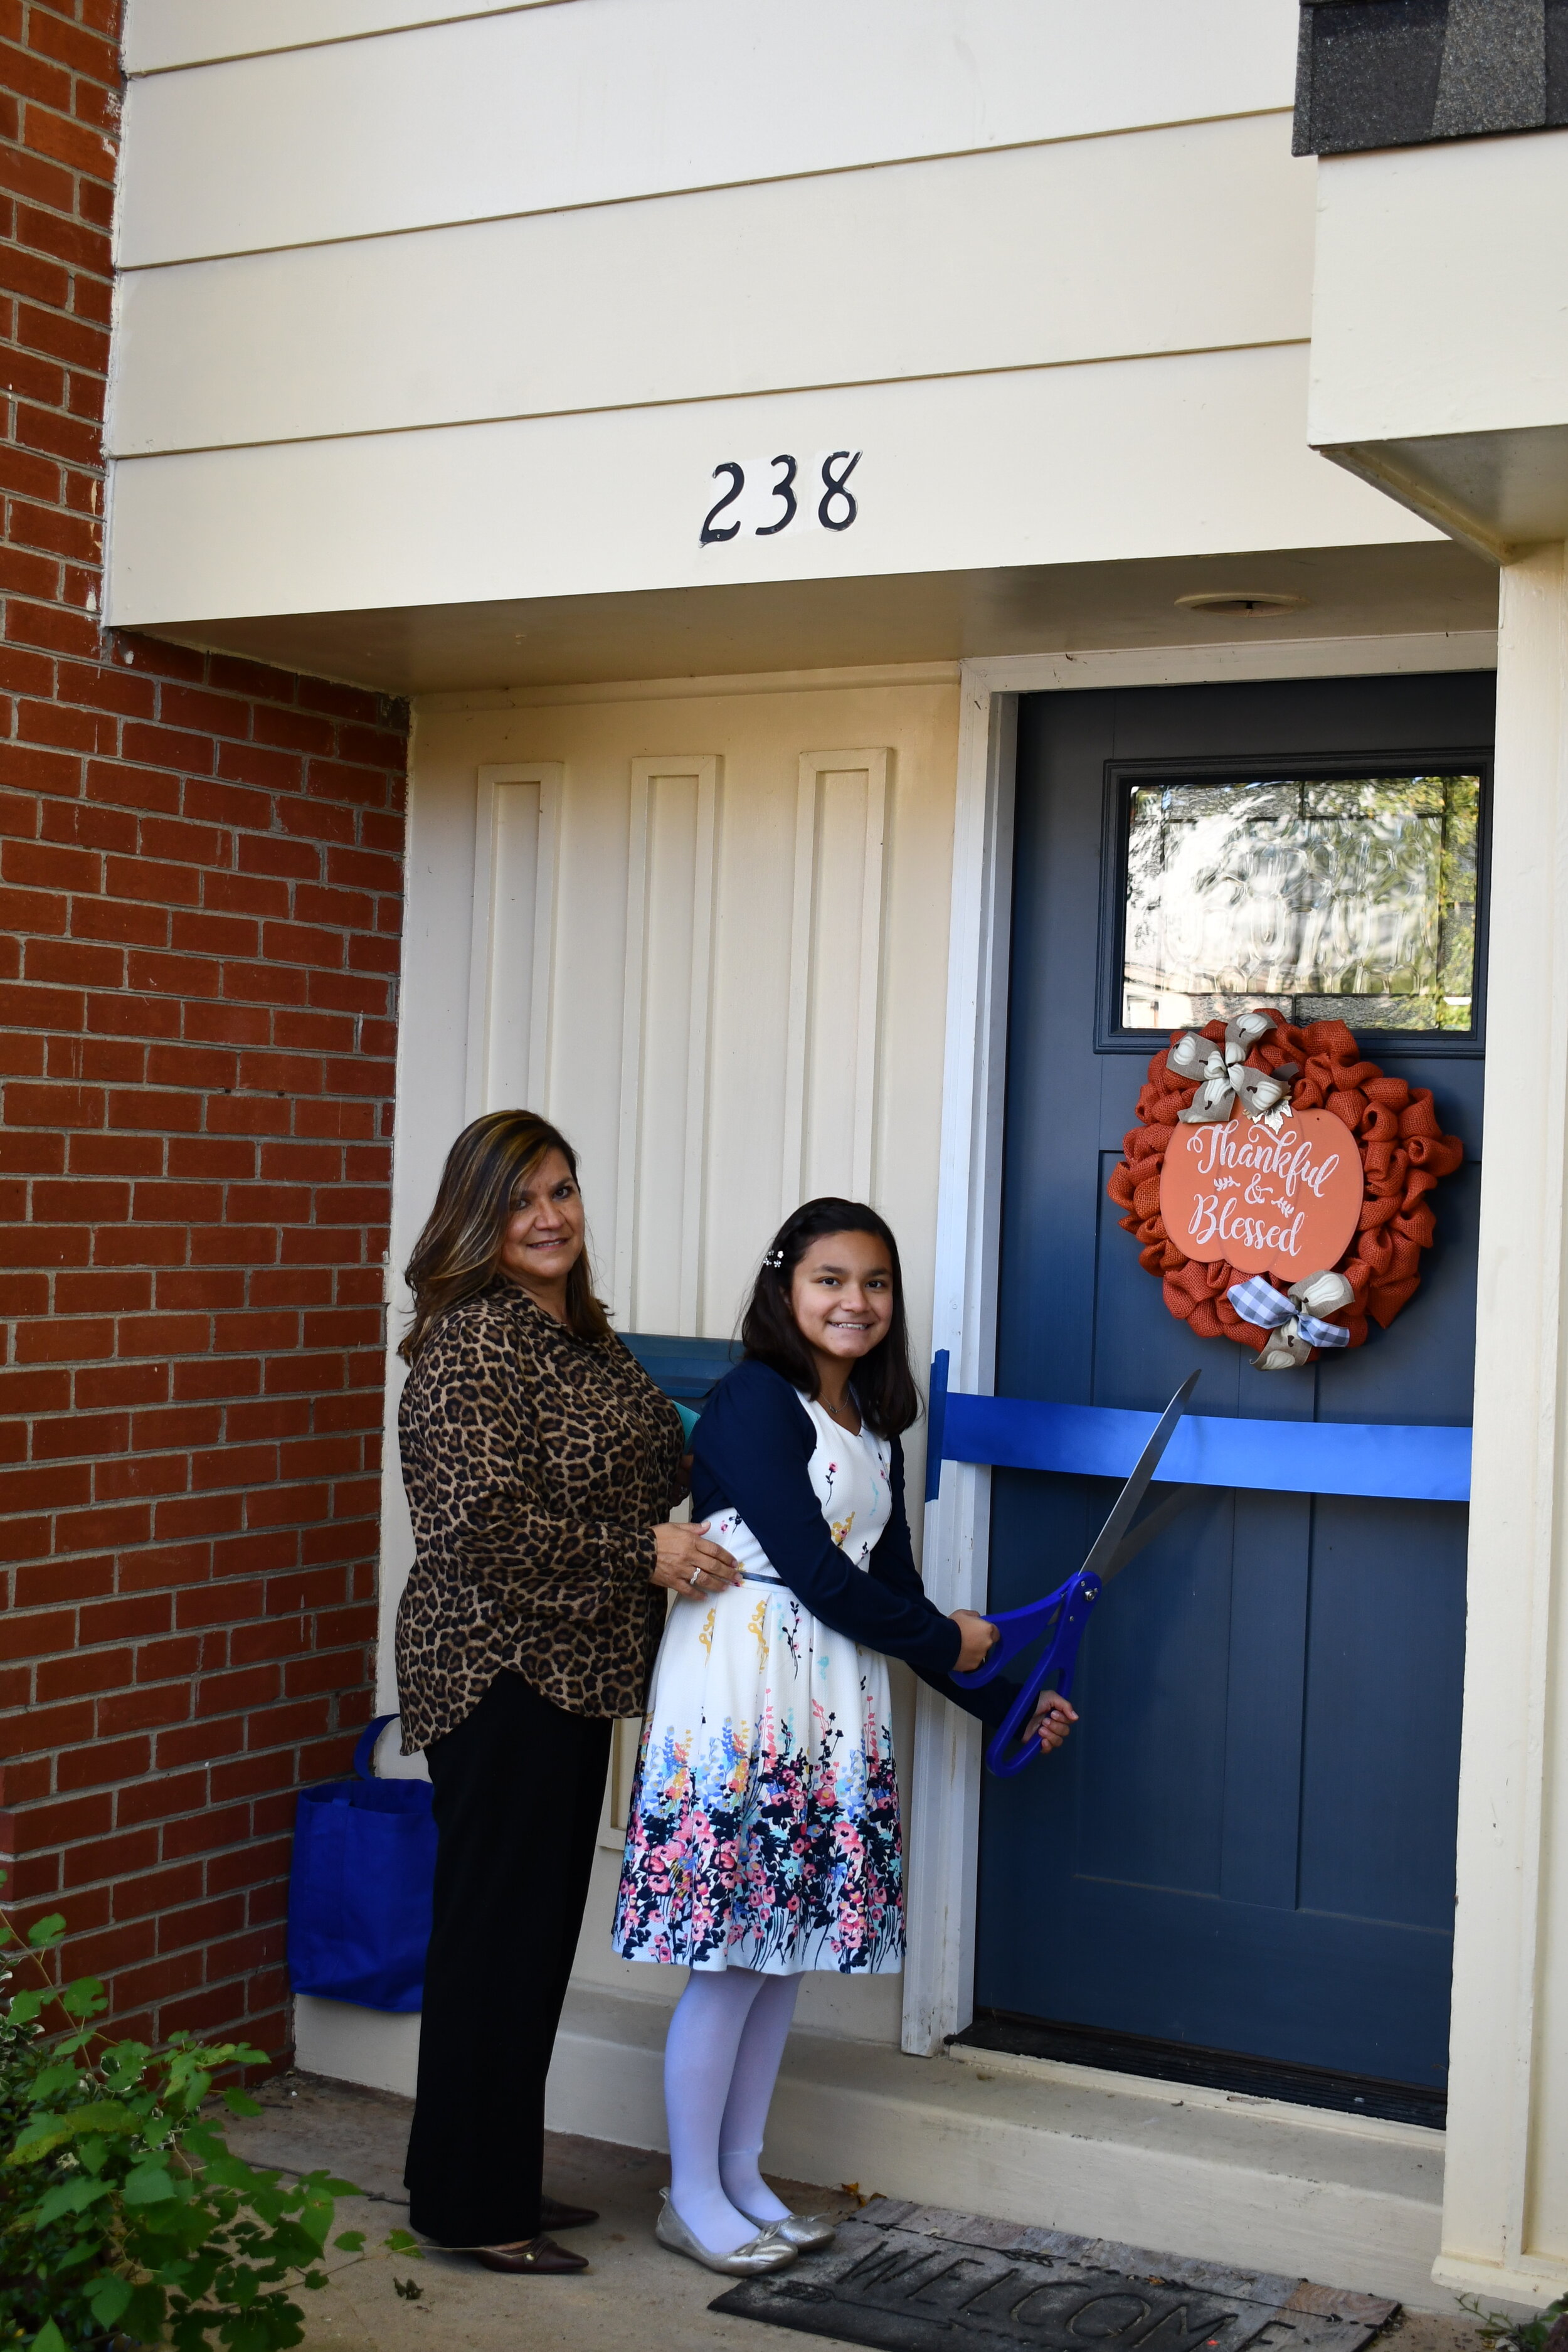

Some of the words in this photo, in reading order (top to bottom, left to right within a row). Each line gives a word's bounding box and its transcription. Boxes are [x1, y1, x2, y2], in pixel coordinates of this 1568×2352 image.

[697, 449, 863, 548] 238
[1186, 1119, 1340, 1198] Thankful
[1244, 1173, 1273, 1204] &
[1188, 1194, 1305, 1257] Blessed
